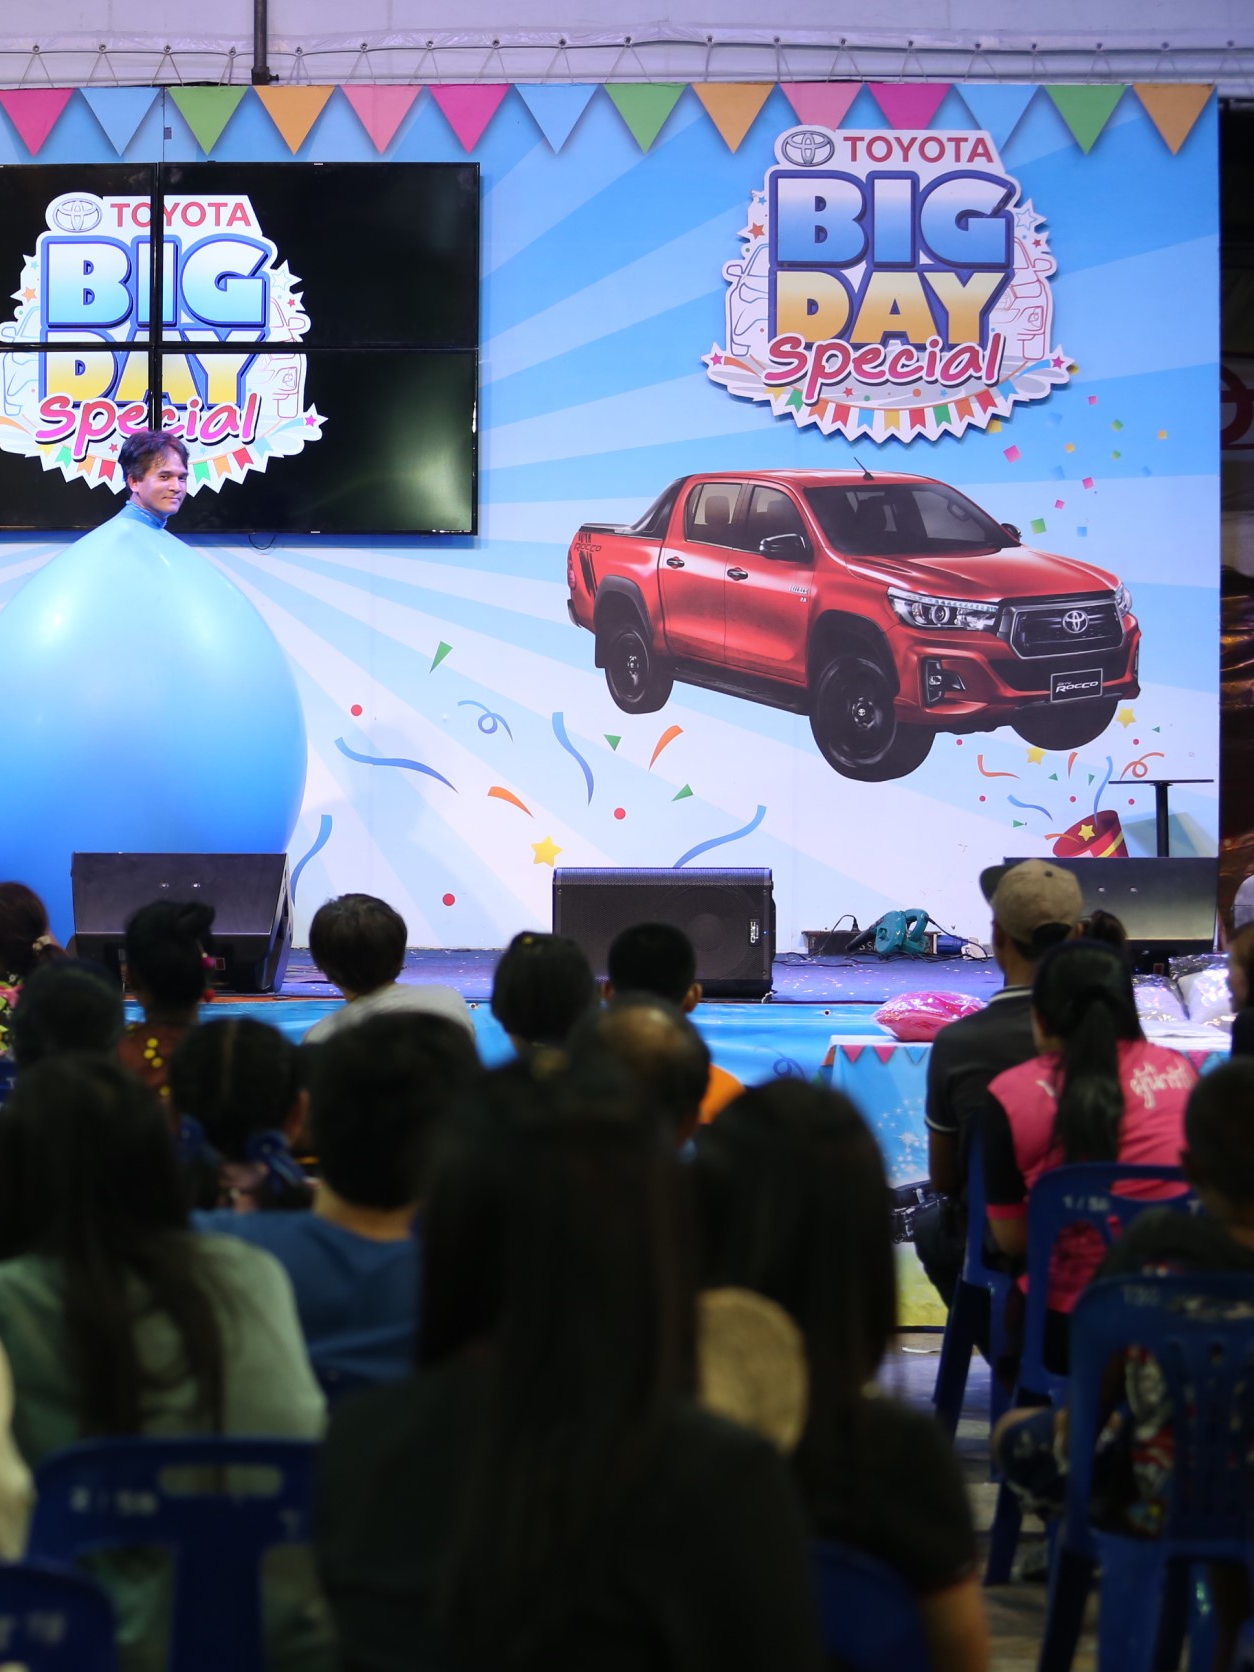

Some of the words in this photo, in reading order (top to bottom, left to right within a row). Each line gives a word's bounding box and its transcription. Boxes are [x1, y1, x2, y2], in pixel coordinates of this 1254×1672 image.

[843, 135, 994, 163] TOYOTA
[110, 201, 252, 228] TOYOTA
[774, 175, 1013, 267] BIG
[45, 237, 271, 328] BIG
[773, 269, 1008, 350] DAY
[45, 328, 268, 408] DAY
[762, 332, 1006, 403] Special
[35, 392, 259, 457] Special
[574, 542, 602, 553] ROCCO
[1055, 681, 1099, 693] ROCCO
